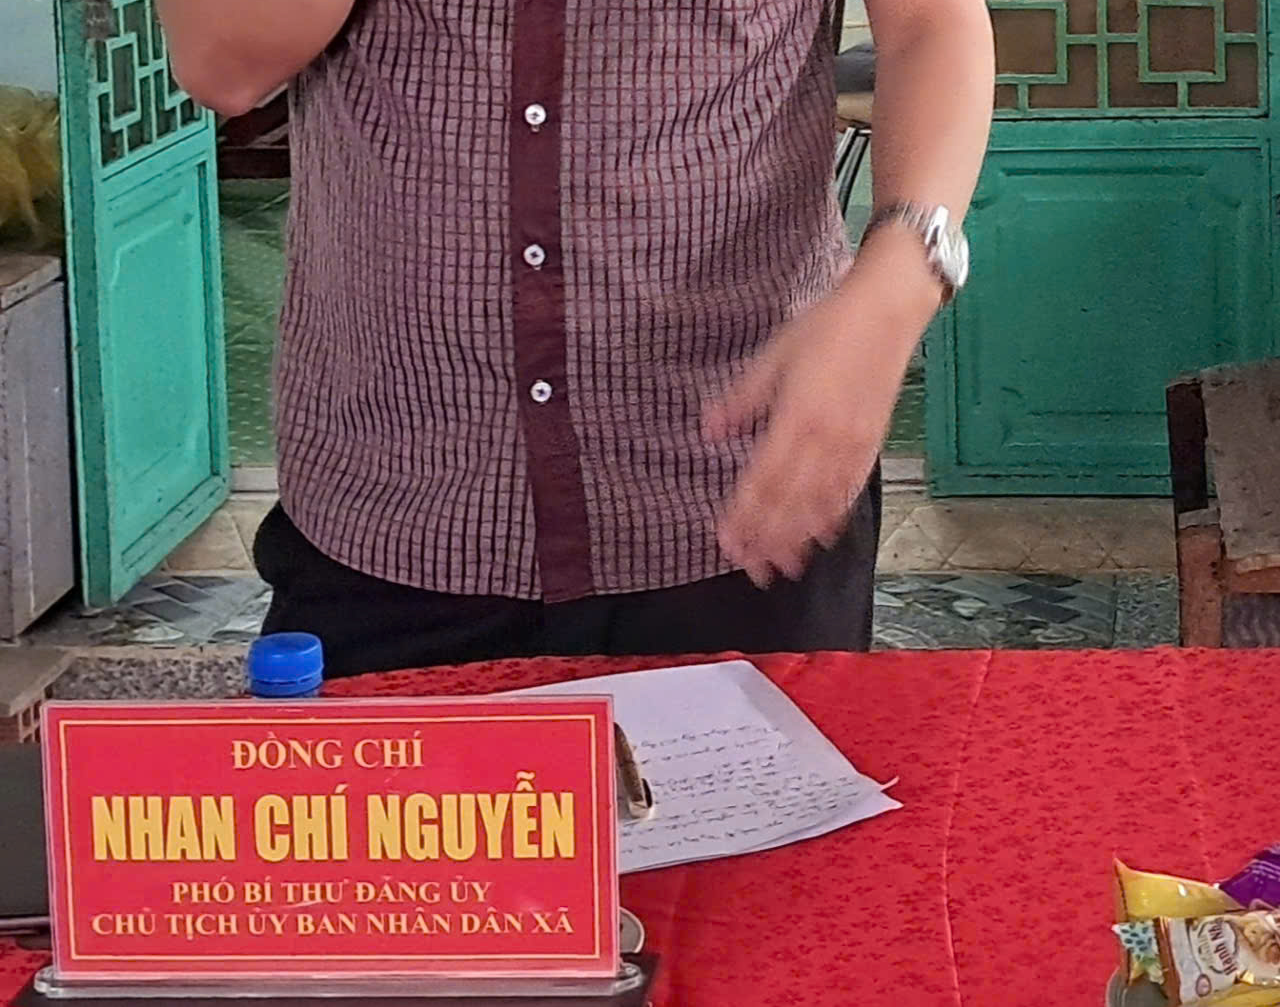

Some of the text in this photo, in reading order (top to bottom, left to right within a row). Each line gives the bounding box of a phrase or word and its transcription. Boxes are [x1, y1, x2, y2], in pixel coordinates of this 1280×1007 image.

[231, 730, 423, 769] ĐỒNG CHÍ
[91, 795, 236, 861] NHAN
[254, 784, 349, 862] CHÍ
[367, 770, 576, 862] NGUYỄN
[171, 875, 491, 904] PHÓ BÍ THƯ ĐẢNG ỦY
[92, 906, 574, 940] CHỦ TỊCH ỦY BAN NHÂN DÂN XÃ
